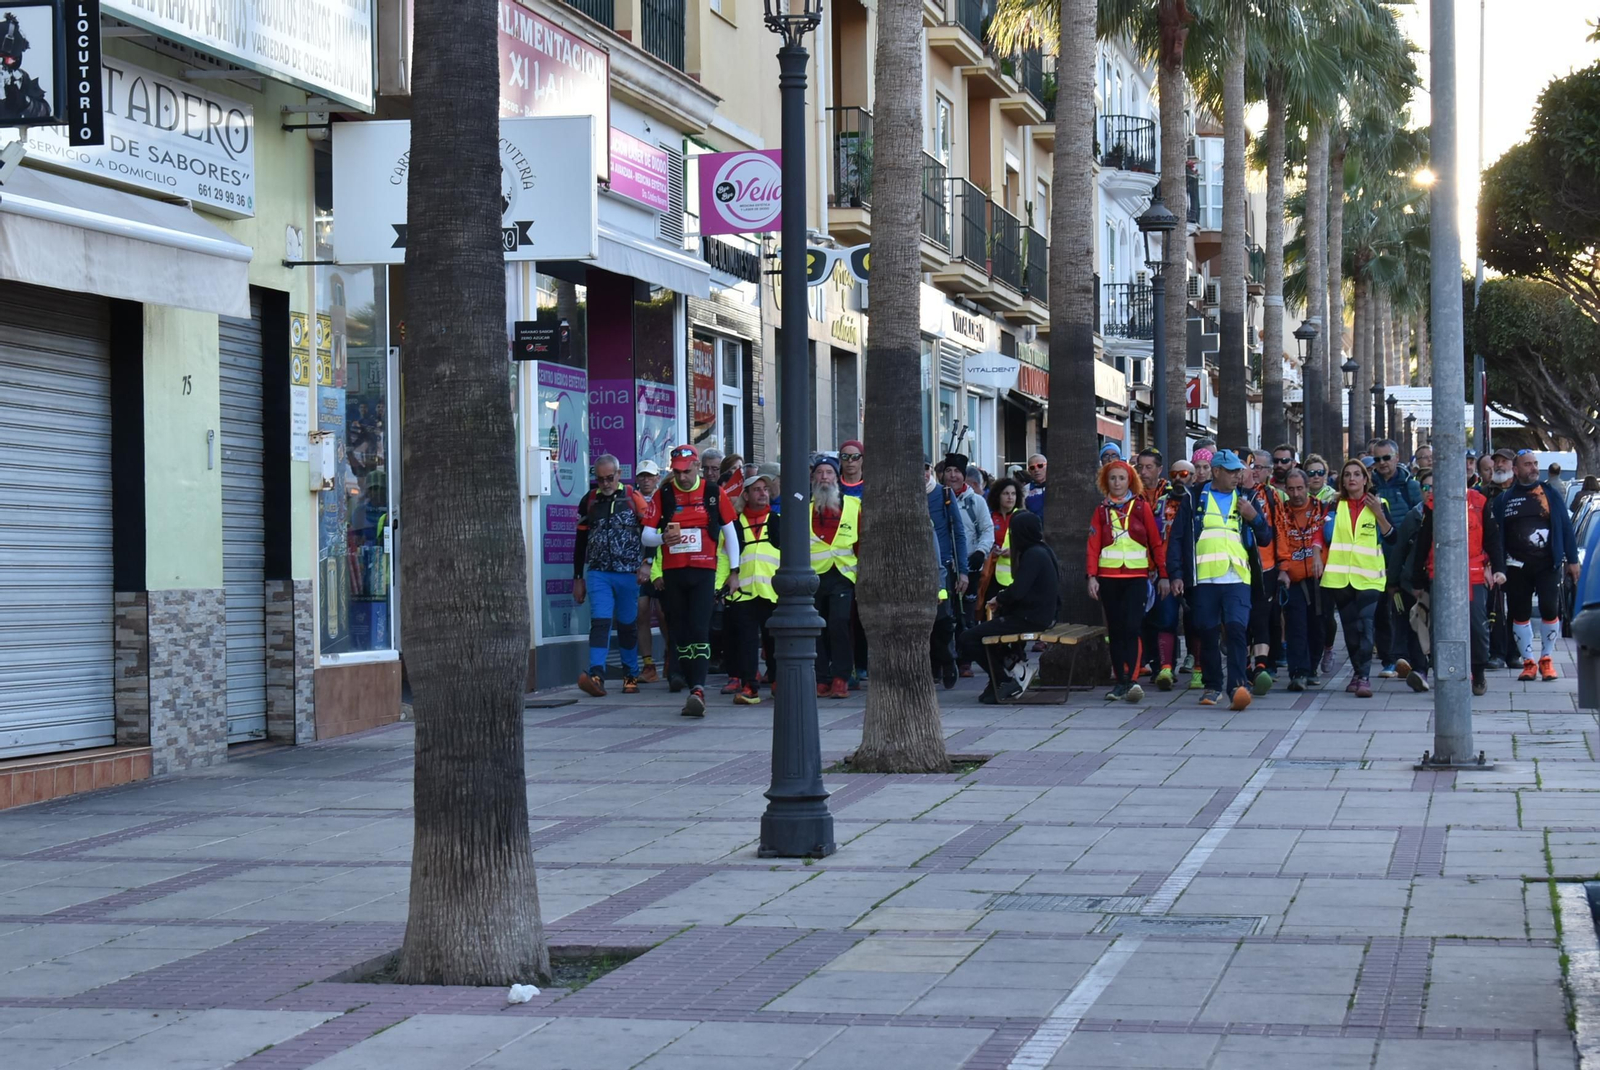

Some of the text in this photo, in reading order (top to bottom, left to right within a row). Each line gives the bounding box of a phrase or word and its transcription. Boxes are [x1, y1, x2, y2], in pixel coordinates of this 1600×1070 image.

[251, 31, 332, 83] VARIEDAD DE QUESOS
[77, 4, 91, 140] LOCUTORIO
[102, 62, 249, 162] TADERO
[110, 135, 140, 158] DE
[29, 138, 178, 187] SERVICIO A DOMICILIO
[198, 183, 246, 207] 661 29 99 36
[952, 311, 985, 343] VITALDENT
[182, 374, 192, 396] 75
[588, 386, 629, 405] cina
[588, 412, 625, 430] tica
